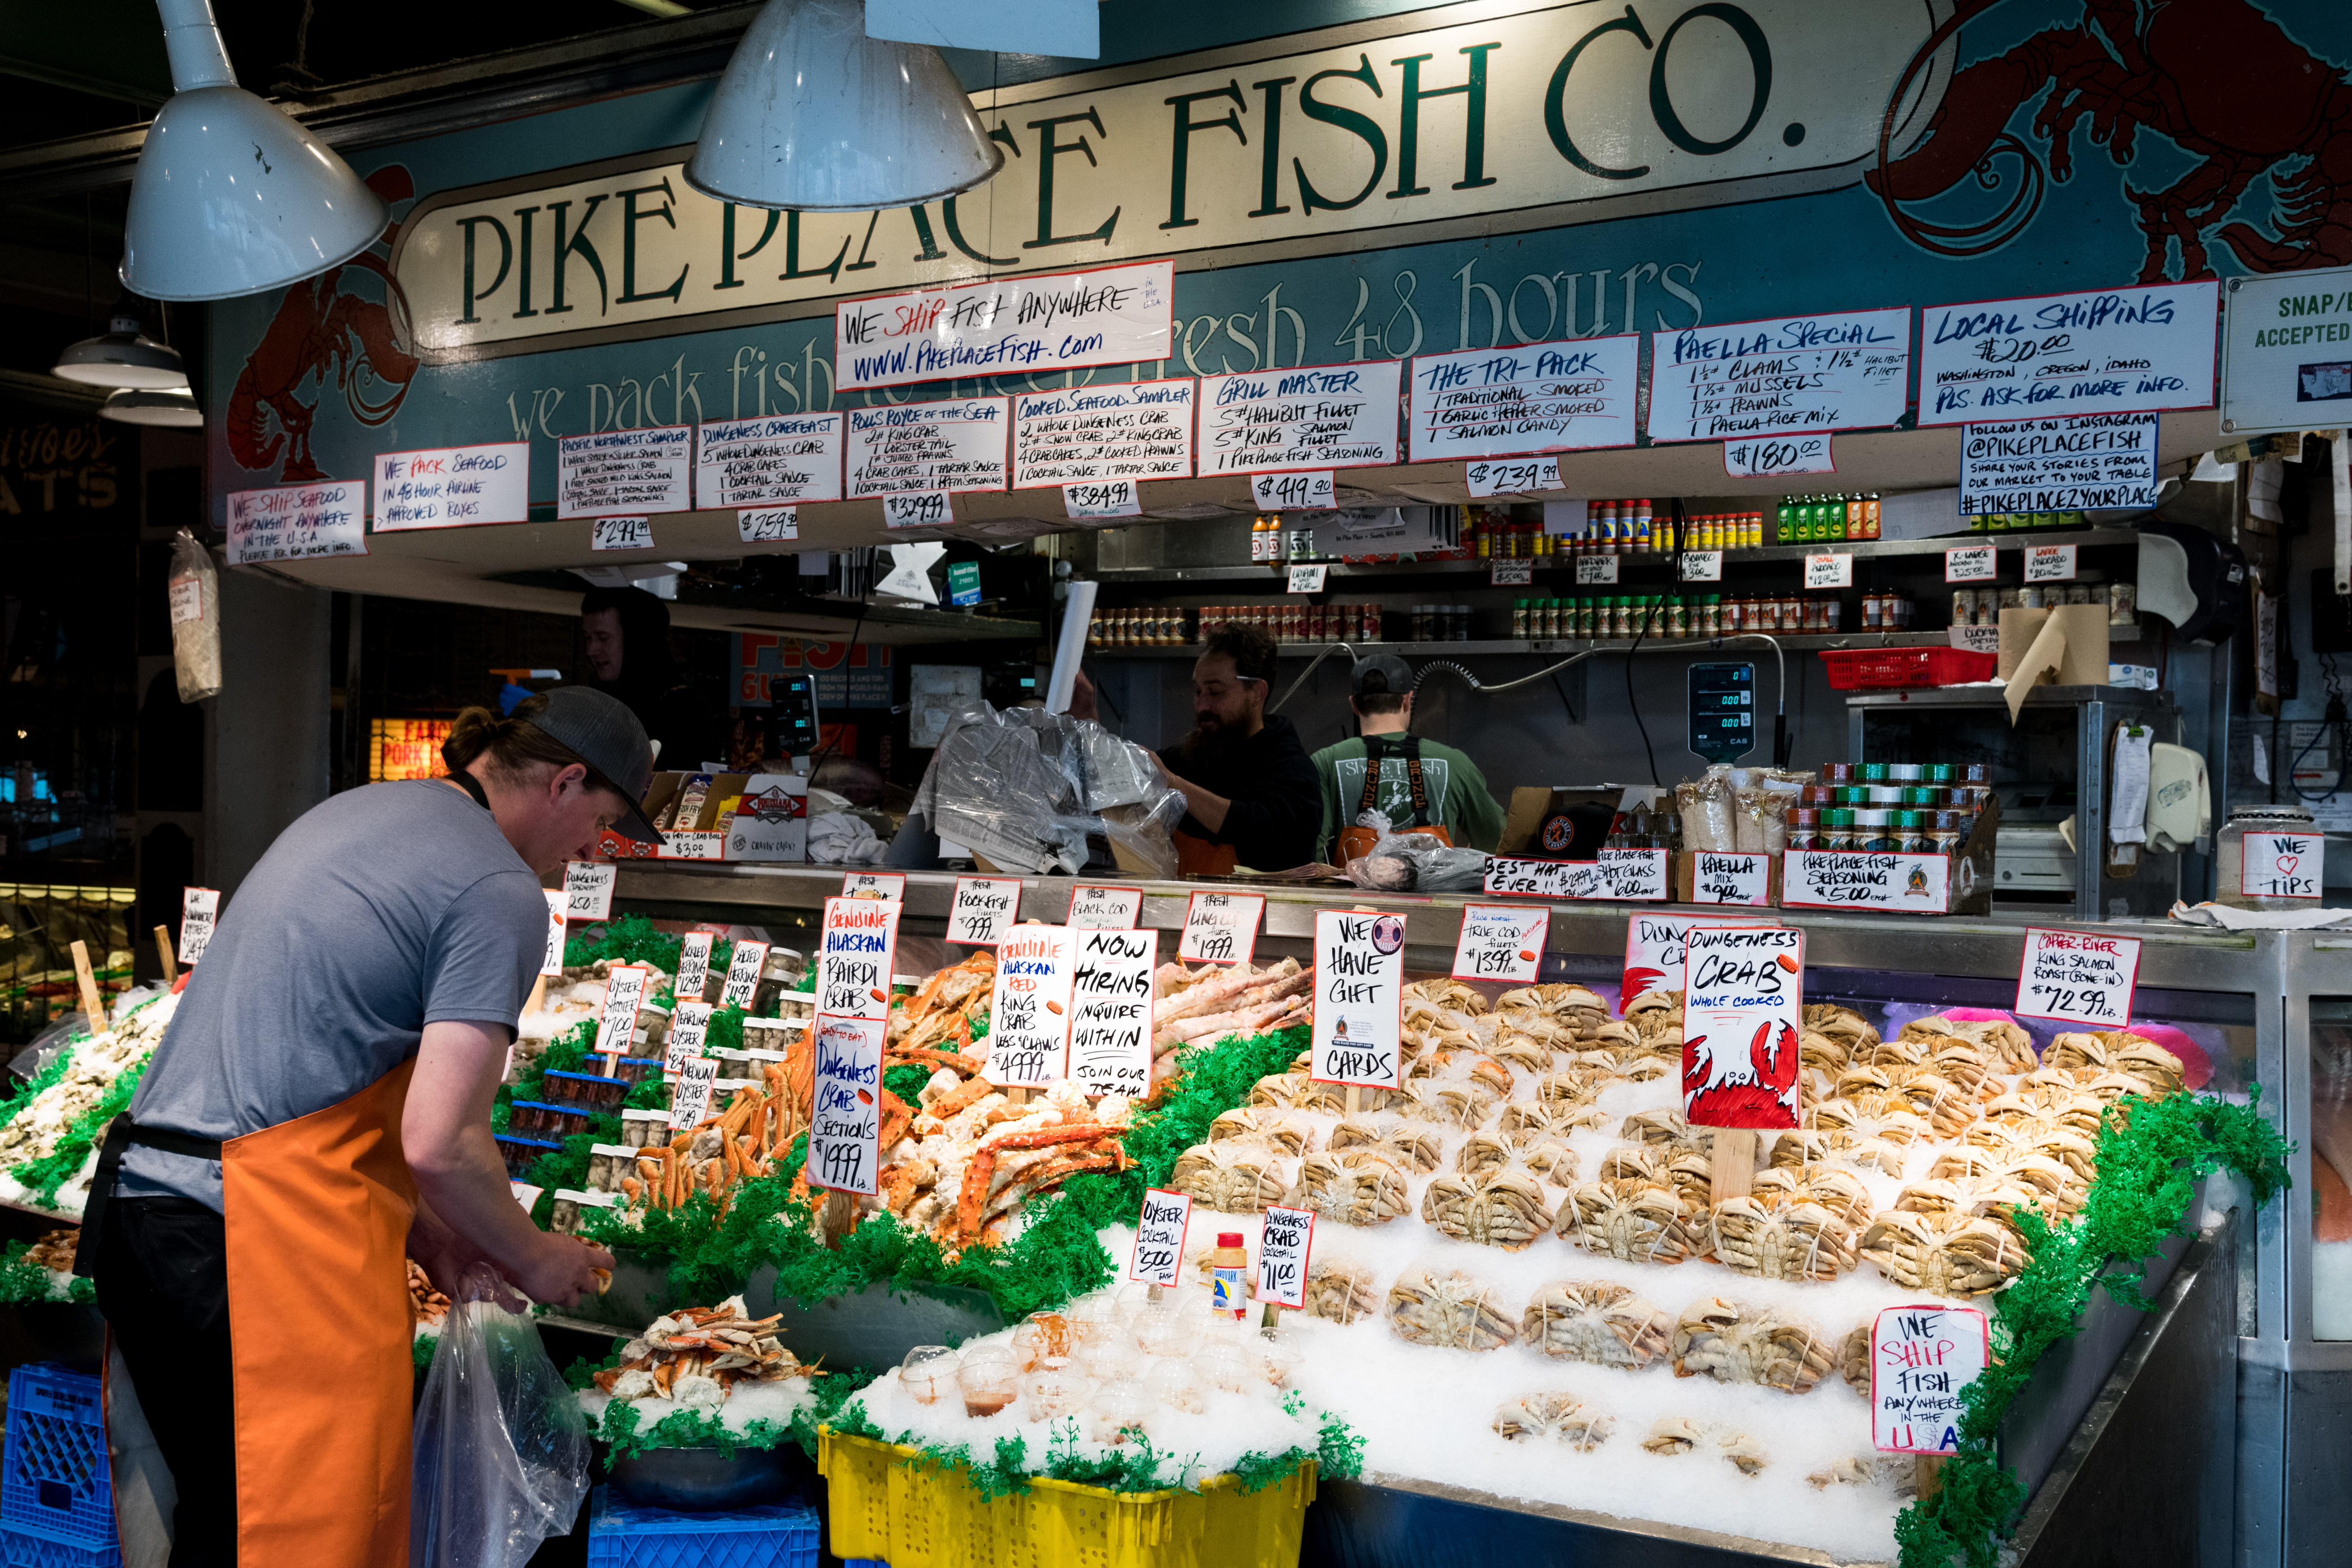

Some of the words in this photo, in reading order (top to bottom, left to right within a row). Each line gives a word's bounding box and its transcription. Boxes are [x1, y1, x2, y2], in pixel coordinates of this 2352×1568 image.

[455, 183, 692, 326] PIKE
[1159, 42, 1503, 230] FISH
[1545, 2, 1806, 180] CO.
[845, 305, 885, 345] WE
[883, 298, 946, 338] SHIP
[1018, 285, 1138, 328] ANYWHERE
[1933, 310, 2025, 345] LOCAL
[2032, 294, 2176, 330] SHIPPING
[1674, 329, 1775, 364] PAELLA
[1777, 321, 1895, 350] SPECIAL
[2255, 323, 2350, 348] ACCEPTED
[507, 387, 566, 442] we
[586, 353, 705, 434] pack
[727, 337, 835, 420] fish
[1130, 282, 1307, 382] resh
[1334, 269, 1424, 363] 48
[1451, 257, 1704, 353] hours
[1418, 362, 1477, 391] THE
[1478, 350, 1604, 385] TRI-PACK
[1216, 377, 1270, 406] GRILL
[1277, 370, 1363, 398] MASTER
[1442, 387, 1533, 407] TRADITIONAL
[1536, 379, 1605, 397] SMOKED
[1735, 372, 1824, 395] MUSSELS
[886, 409, 922, 428] ROYCE
[925, 409, 938, 420] OF
[941, 407, 963, 420] THE
[963, 401, 1001, 420] SEA
[1017, 397, 1066, 421] COOKED
[1125, 385, 1191, 407] SAMPLER
[1246, 403, 1313, 426] HALIBUT
[1312, 402, 1367, 421] FILLET
[1729, 393, 1793, 415] PRAWNS
[2066, 413, 2157, 430] INSTAGRAM
[561, 437, 592, 452] PACIFIC
[594, 433, 645, 449] NORTHWEST
[646, 430, 690, 444] SAMPLER
[703, 424, 763, 447] DUNGENESS
[1967, 430, 2143, 459] @PIKEPLACEFISH
[384, 461, 407, 480] WE
[410, 456, 447, 477] PACK
[452, 454, 508, 472] SEAFOOD
[1729, 440, 1822, 471] $180.00
[1970, 461, 2005, 474] SHARE
[2010, 460, 2037, 473] YOUR
[2041, 459, 2100, 470] STORIES
[2104, 455, 2147, 467] FROM
[383, 487, 396, 503] IN
[397, 484, 413, 500] 48
[414, 484, 442, 498] HOUR
[446, 480, 487, 495] AIRLINE
[1068, 481, 1131, 506] $384.99
[1257, 475, 1332, 504] $419.90
[387, 504, 438, 522] APPROVED
[446, 502, 480, 517] BOXES
[888, 493, 945, 520] $329.99
[234, 513, 293, 534] OVERNIGHT
[295, 512, 353, 528] ANYWHERE
[751, 841, 775, 851] CRAVIN'
[2273, 837, 2310, 855] WE
[1485, 859, 1527, 876] BEST
[1534, 862, 1569, 877] HAT
[1700, 853, 1758, 875] PAELLA
[1492, 875, 1538, 892] EVER
[1807, 869, 1887, 885] SEASONING
[2258, 876, 2314, 896] TIPS
[959, 891, 1010, 910] ROCKFISH
[1072, 901, 1105, 917] BLACK
[1108, 902, 1128, 917] COD
[828, 901, 889, 930] GENUINE
[826, 929, 886, 953] ALASKAN
[1339, 917, 1375, 943] WE
[1463, 922, 1496, 938] TRUE
[1497, 926, 1521, 938] COD
[1689, 932, 1799, 949] DUNGENESS
[734, 943, 760, 963] SALTED
[1086, 931, 1147, 960] NOW
[1377, 941, 1397, 952] MARKET
[678, 960, 707, 976] HERRING
[826, 955, 878, 986] BAIRDI
[1326, 946, 1386, 975] HAVE
[2037, 951, 2067, 967] KING
[2069, 955, 2115, 971] SALMON
[1009, 975, 1037, 992] RED
[1075, 959, 1149, 999] HIRING
[1694, 954, 1782, 994] CRAB
[609, 978, 644, 995] OYSTER
[823, 984, 867, 1010] CRAB
[1329, 978, 1384, 1004] GIFT
[602, 997, 637, 1017] SHOOTER
[999, 993, 1036, 1013] KING
[1691, 995, 1731, 1007] WHOLE
[1732, 995, 1785, 1007] COOKED
[2031, 984, 2106, 1017] $72.99
[1076, 1003, 1146, 1024] INQUIRE
[1076, 1026, 1141, 1048] WITHIN
[681, 1059, 714, 1081] MEDIUM
[817, 1040, 877, 1085] DUNGENESS
[1326, 1050, 1394, 1080] CARDS
[813, 1110, 876, 1139] SECTIONS
[813, 1138, 862, 1188] $19.99
[1143, 1200, 1184, 1226] OYSTER
[1265, 1209, 1310, 1229] DUNGENESS
[1138, 1224, 1179, 1247] COCKTAIL
[1264, 1227, 1300, 1247] CRAB
[1263, 1246, 1297, 1259] COCKTAIL
[1215, 1269, 1238, 1283] AARDVARK
[1898, 1312, 1945, 1341] WE
[1881, 1340, 1955, 1368] SHIP
[1896, 1367, 1959, 1393] FISH
[1884, 1395, 1967, 1412] ANYWHERE
[1901, 1410, 1911, 1422] IN
[1914, 1412, 1945, 1422] THE
[1891, 1424, 1960, 1451] USA
